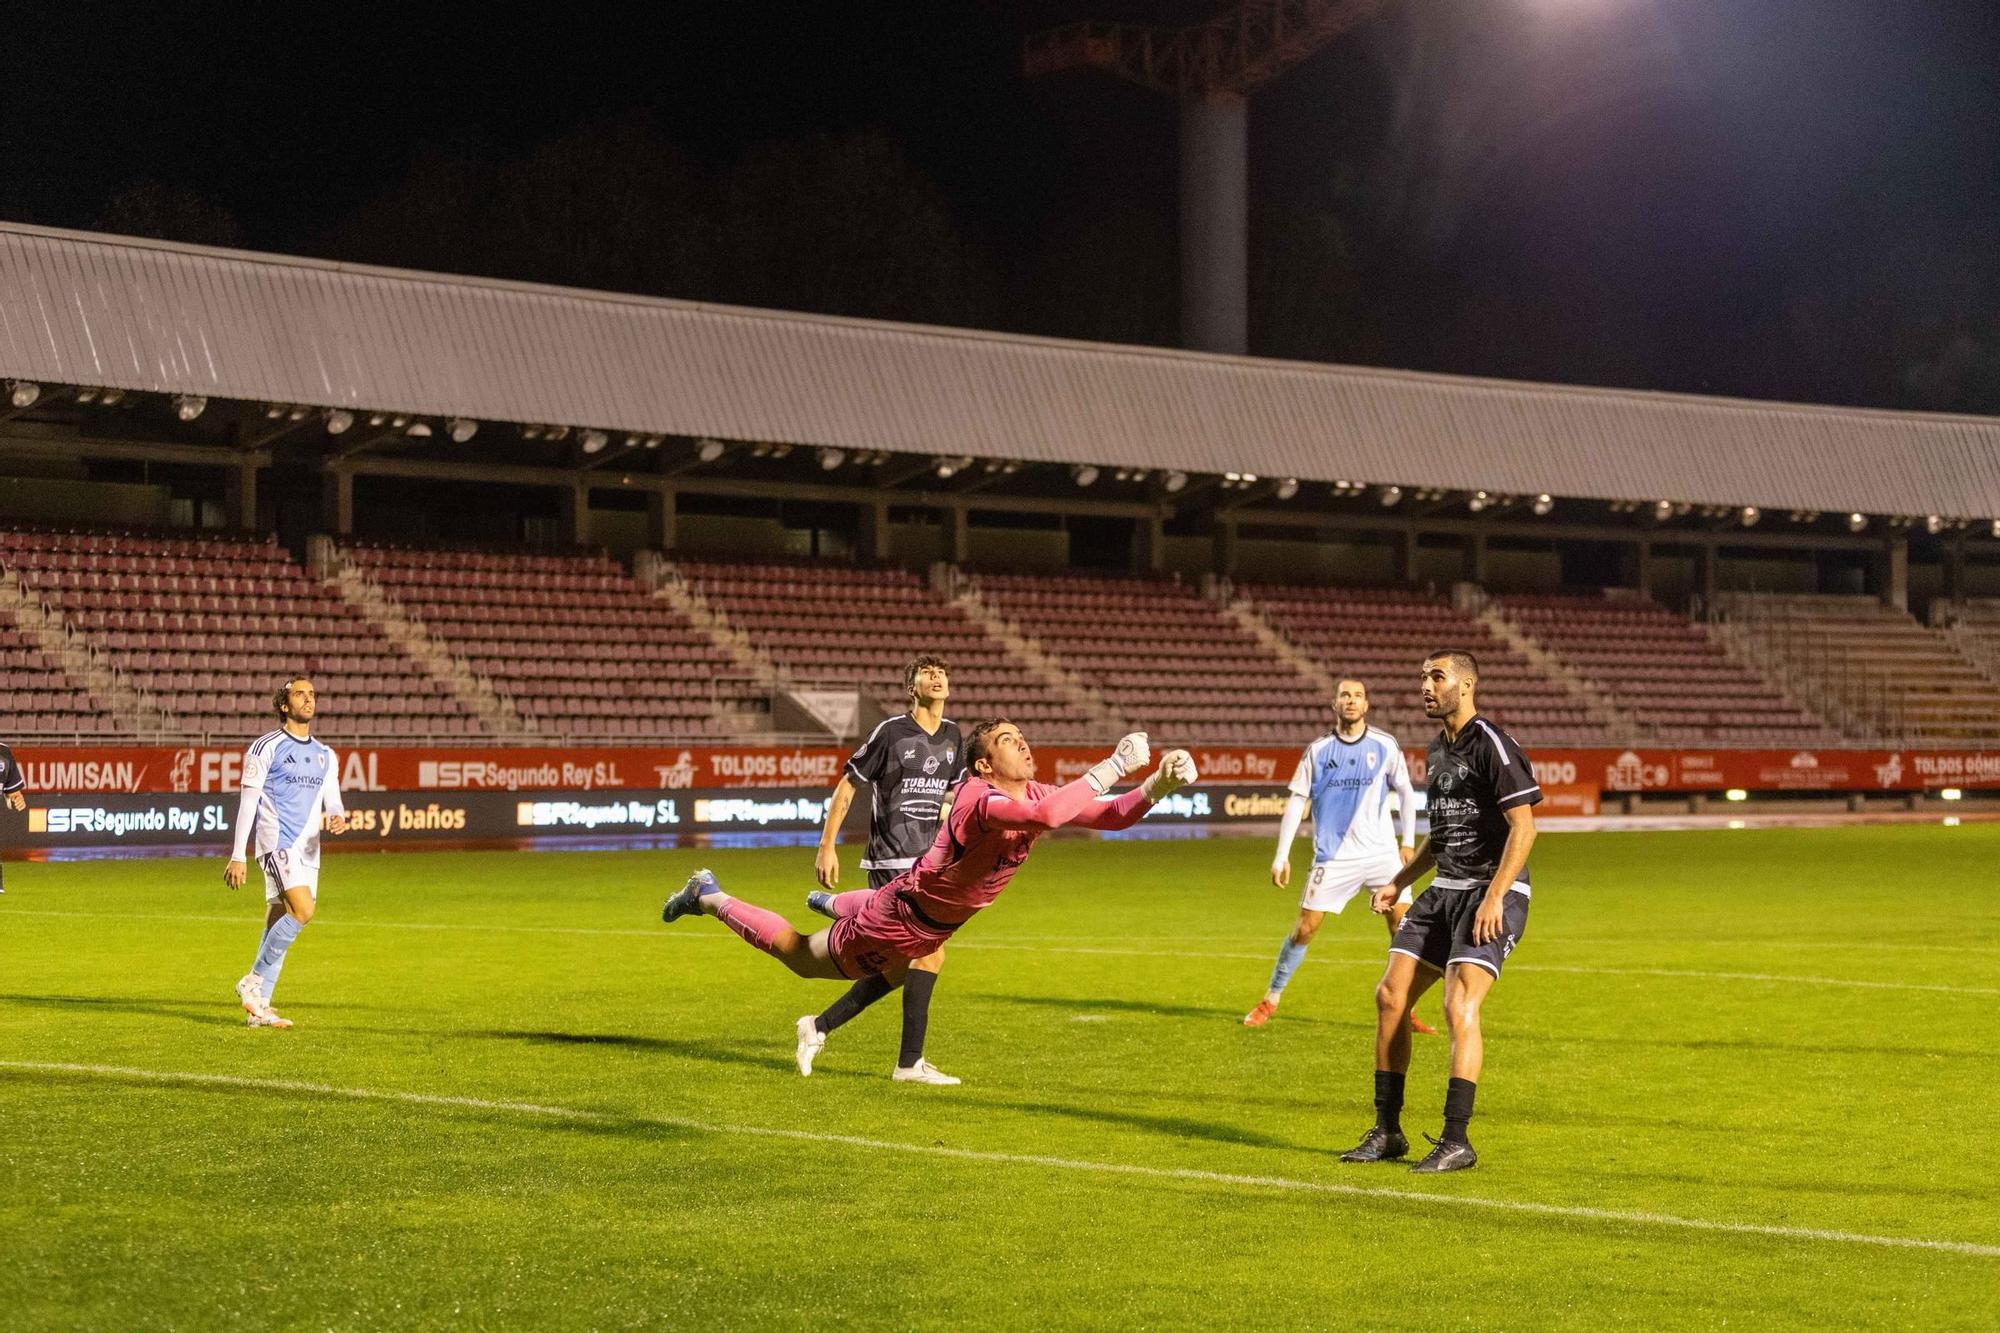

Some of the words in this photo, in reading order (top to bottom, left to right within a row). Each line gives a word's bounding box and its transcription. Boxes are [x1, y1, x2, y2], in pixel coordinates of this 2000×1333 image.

[562, 762, 593, 790] Rey
[711, 755, 776, 776] TOLDOS
[780, 750, 837, 776] GÓMEZ
[1199, 753, 1243, 775] Julio
[1245, 752, 1277, 780] Rey
[1915, 756, 1963, 774] TOLDOS
[1965, 751, 2000, 774] GÓME
[94, 807, 165, 836] Segundo
[168, 807, 199, 834] Rey
[203, 805, 229, 831] SL
[380, 809, 395, 837] y
[400, 803, 466, 829] baños
[1313, 866, 1325, 885] 8
